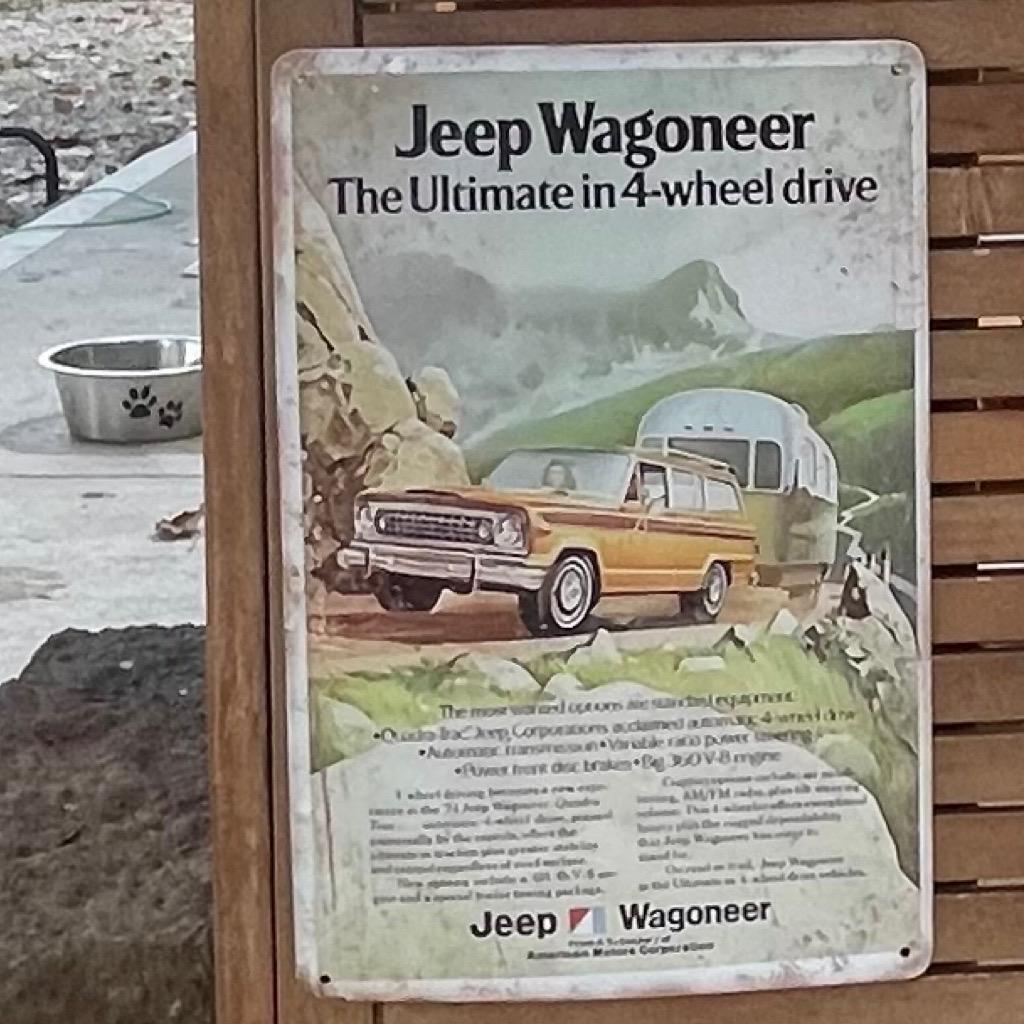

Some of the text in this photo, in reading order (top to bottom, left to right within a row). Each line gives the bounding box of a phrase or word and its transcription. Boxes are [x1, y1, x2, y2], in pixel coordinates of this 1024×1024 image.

[394, 101, 816, 172] Jeep Wagoneer
[328, 167, 879, 216] The Ultimate in 4-wheel drive
[470, 901, 772, 939] Jeep Wagoneer
